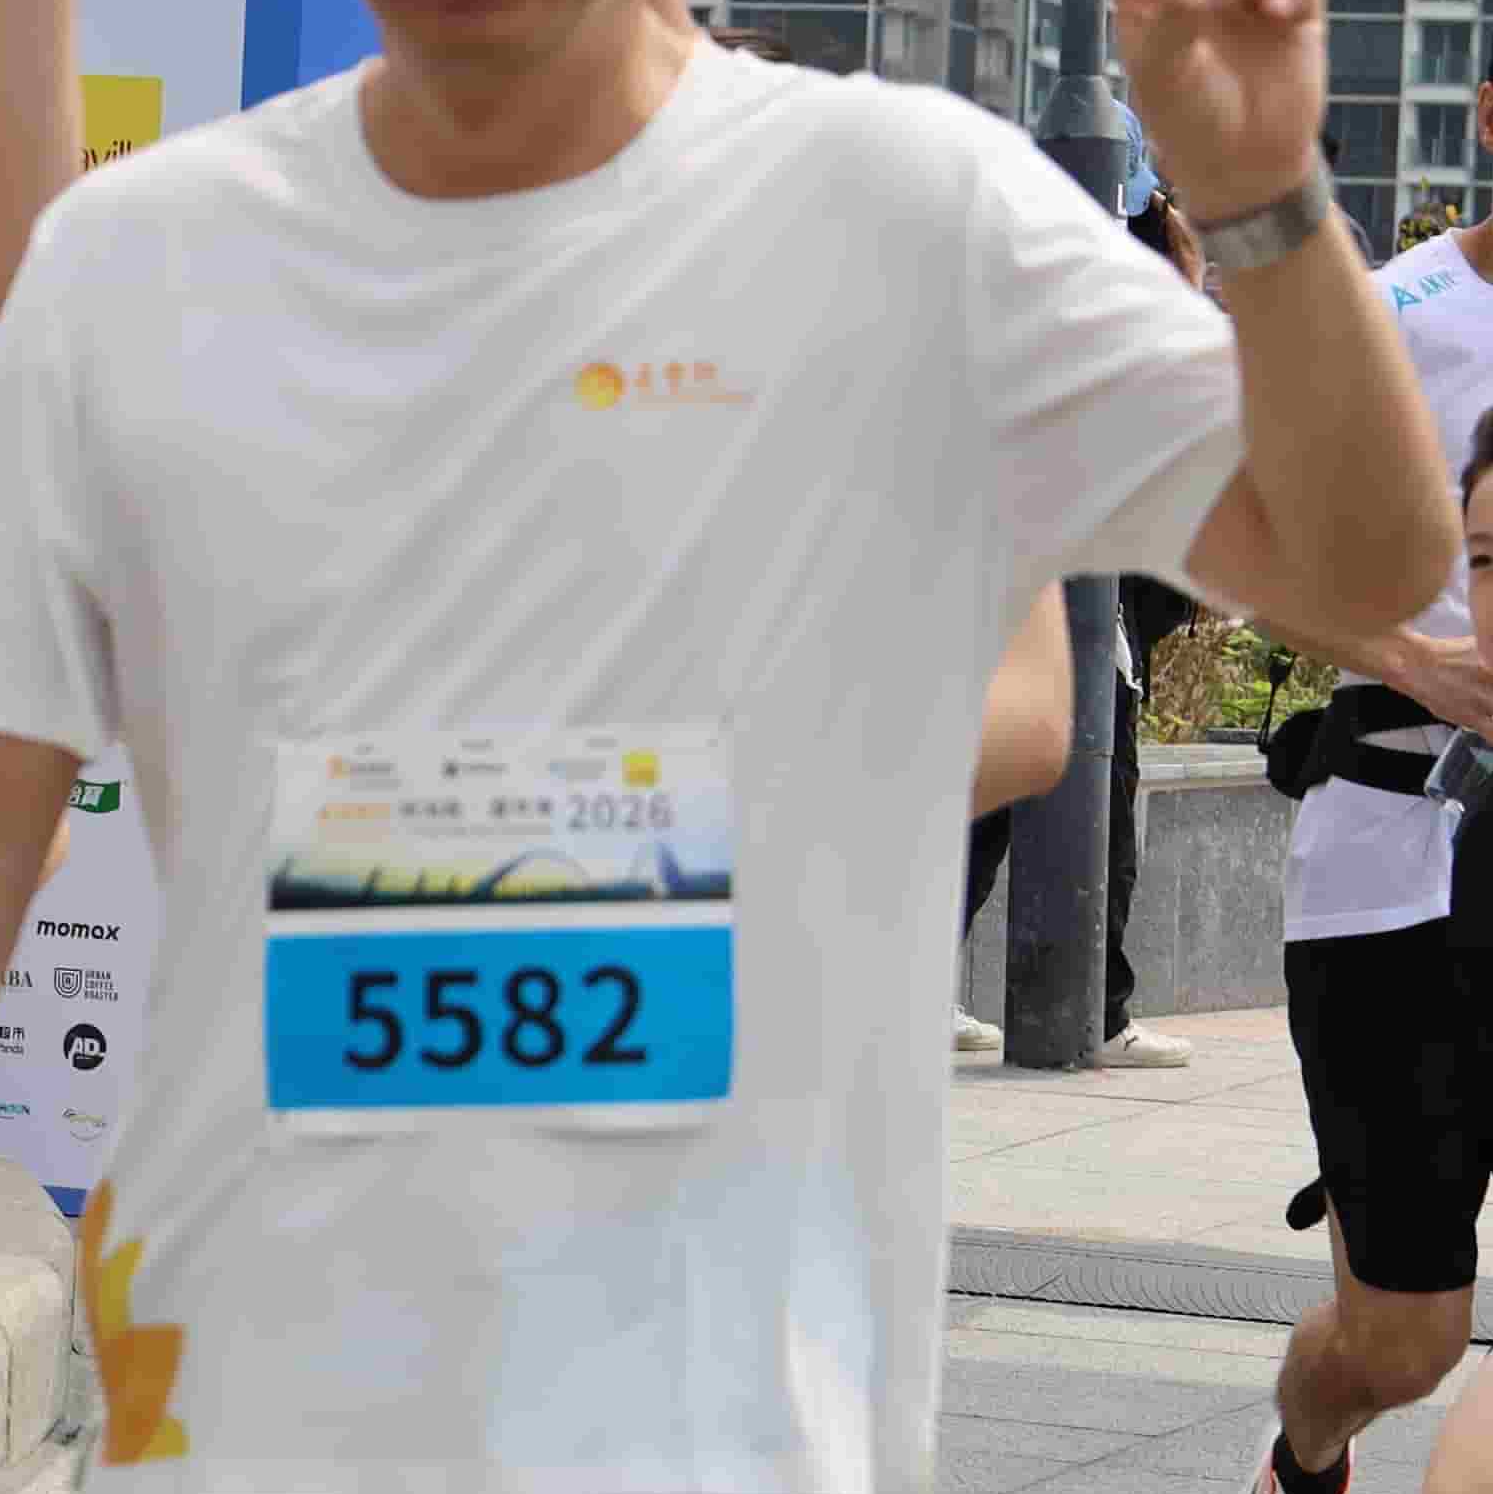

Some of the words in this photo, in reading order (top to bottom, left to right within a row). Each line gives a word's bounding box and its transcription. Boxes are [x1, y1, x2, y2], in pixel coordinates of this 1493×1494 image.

[568, 793, 675, 832] 2026
[36, 919, 122, 941] momax
[342, 963, 649, 1071] 5582
